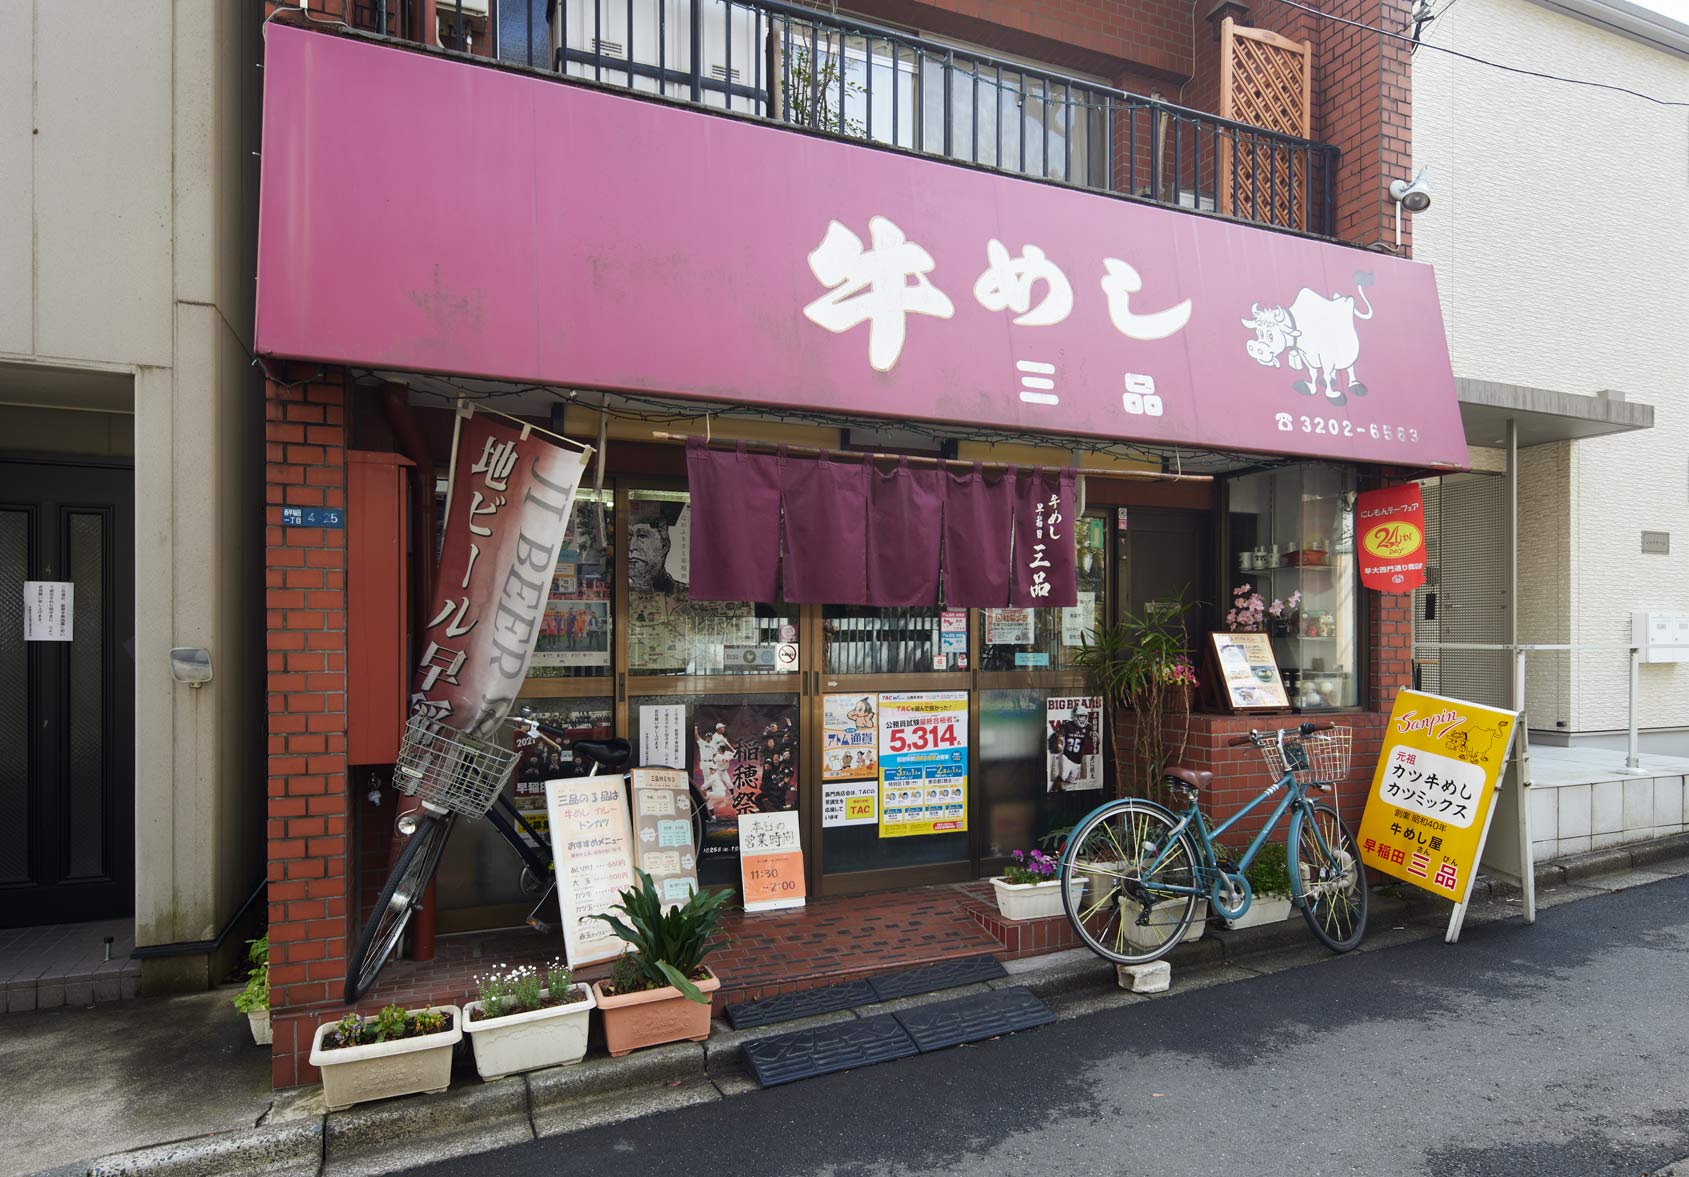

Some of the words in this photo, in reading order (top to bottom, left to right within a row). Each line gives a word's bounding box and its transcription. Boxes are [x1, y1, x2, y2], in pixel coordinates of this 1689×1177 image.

[803, 215, 1192, 372] 牛めし
[1016, 360, 1164, 417] 三品
[307, 512, 316, 522] 4
[1047, 494, 1063, 540] 牛めし
[1048, 699, 1066, 710] BIG
[1393, 708, 1466, 739] Sanpin
[827, 732, 873, 747] アトム通貨
[889, 724, 957, 753] 5,314
[1396, 751, 1417, 766] 元祖
[732, 737, 761, 815] 稲穂祭
[1391, 763, 1473, 801] カツ牛めし
[850, 804, 871, 815] TAC
[1387, 782, 1469, 820] カツミックス
[579, 817, 610, 830] トンカツ
[751, 820, 786, 833] 本日の
[567, 837, 624, 851] おすすめメニュー
[744, 831, 796, 849] 営業時間
[1390, 822, 1444, 852] 牛めし屋
[749, 867, 779, 881] 11:30
[1362, 838, 1405, 866] 早稲田
[1407, 852, 1459, 892] 三品
